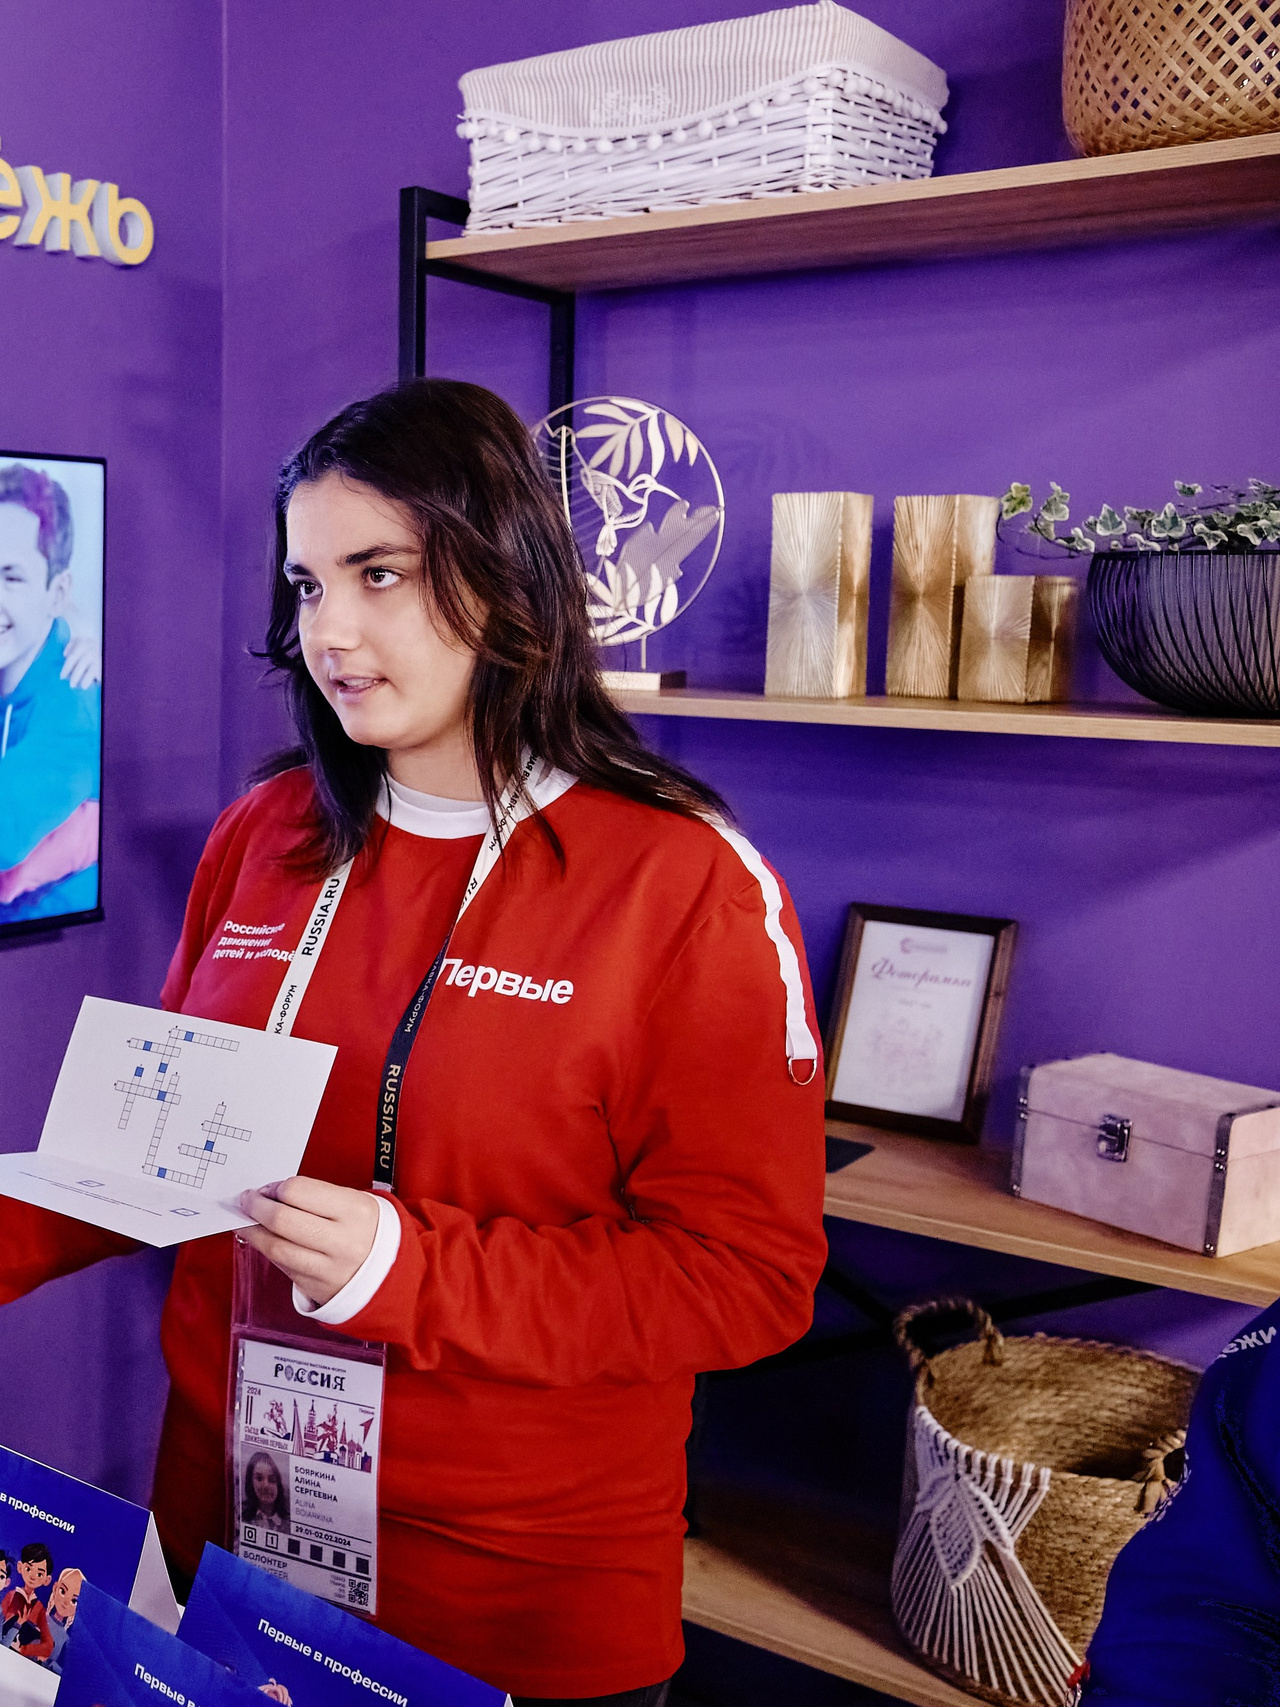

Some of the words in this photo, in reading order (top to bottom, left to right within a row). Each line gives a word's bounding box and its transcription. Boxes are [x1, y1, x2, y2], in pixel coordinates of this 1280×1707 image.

[301, 878, 341, 957] RUSSIA.RU
[436, 958, 574, 1005] Первые
[379, 1063, 403, 1170] RUSSIA.RU
[247, 1386, 261, 1396] 2024
[294, 1466, 336, 1483] БОЯРКИНА
[294, 1477, 322, 1489] АЛИНА
[294, 1486, 338, 1503] СЕРГЕЕВНА
[0, 1492, 7, 1502] в
[8, 1496, 76, 1534] профессии
[243, 1550, 288, 1569] ВОЛОНТЕР
[258, 1618, 312, 1657] Первые
[313, 1650, 322, 1662] в
[324, 1656, 408, 1707] профессии
[134, 1662, 186, 1706] Первые
